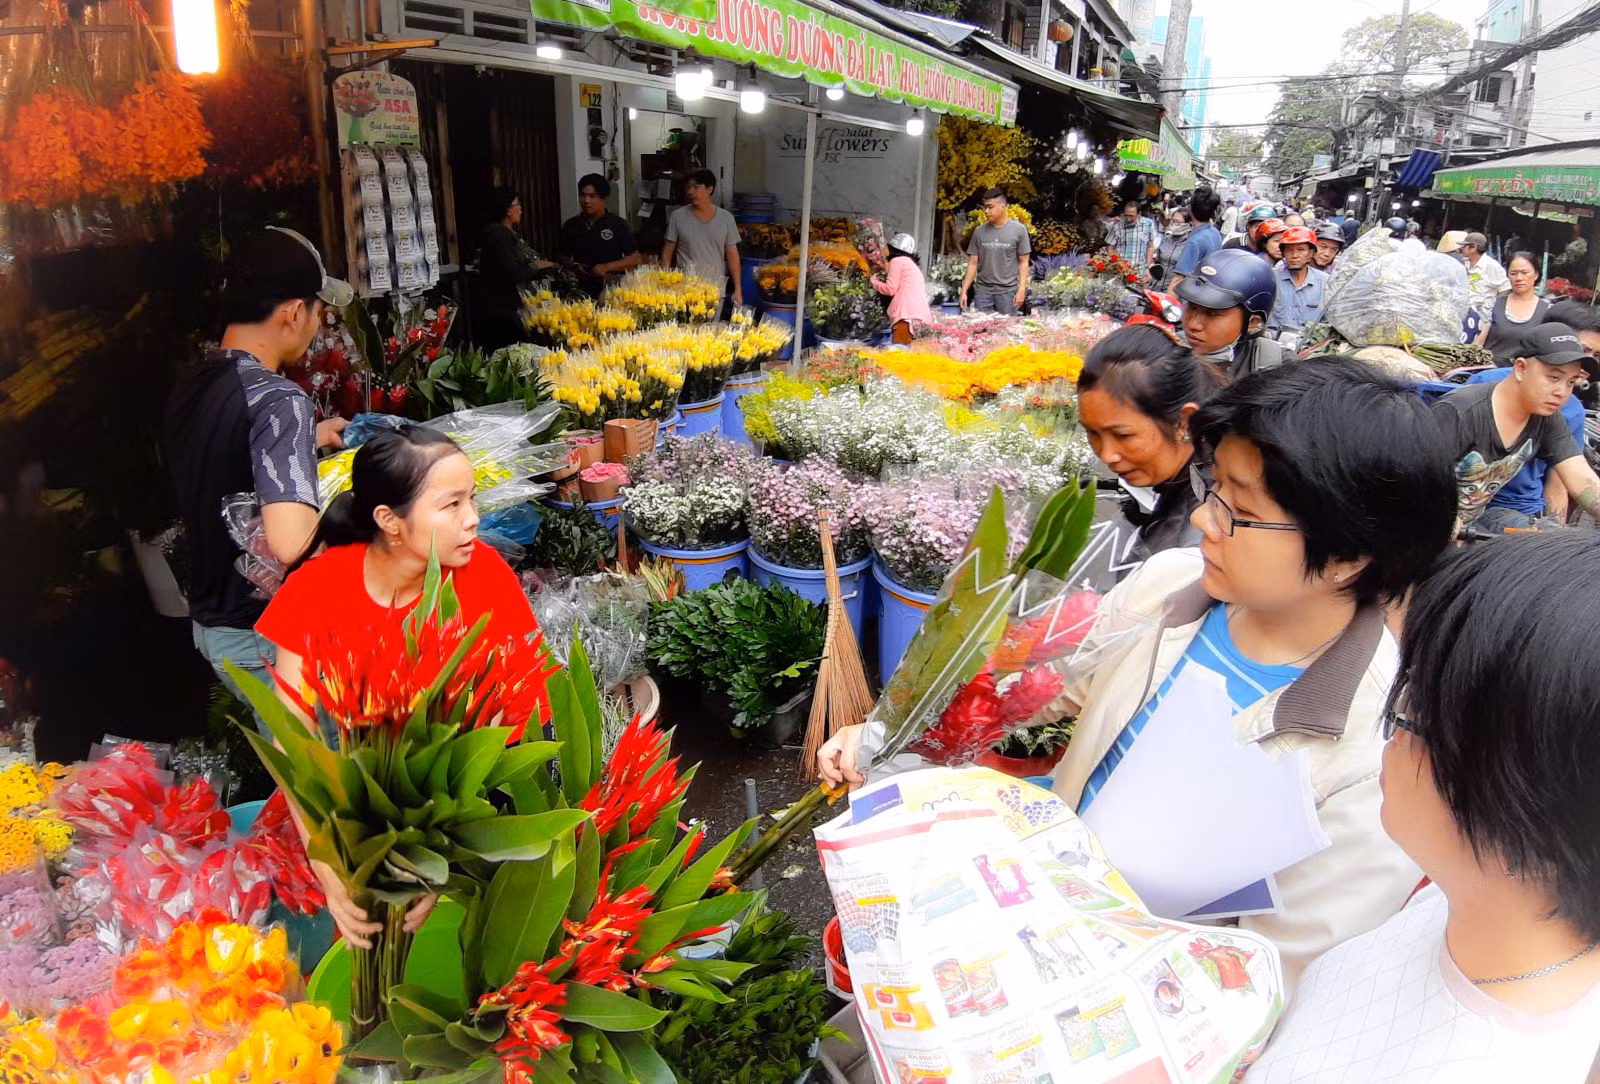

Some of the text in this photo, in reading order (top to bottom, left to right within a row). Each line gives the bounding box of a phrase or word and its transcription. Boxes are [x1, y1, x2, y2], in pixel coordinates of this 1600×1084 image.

[868, 48, 894, 95] LẠT
[899, 57, 921, 96] HOA
[384, 98, 411, 112] ASA
